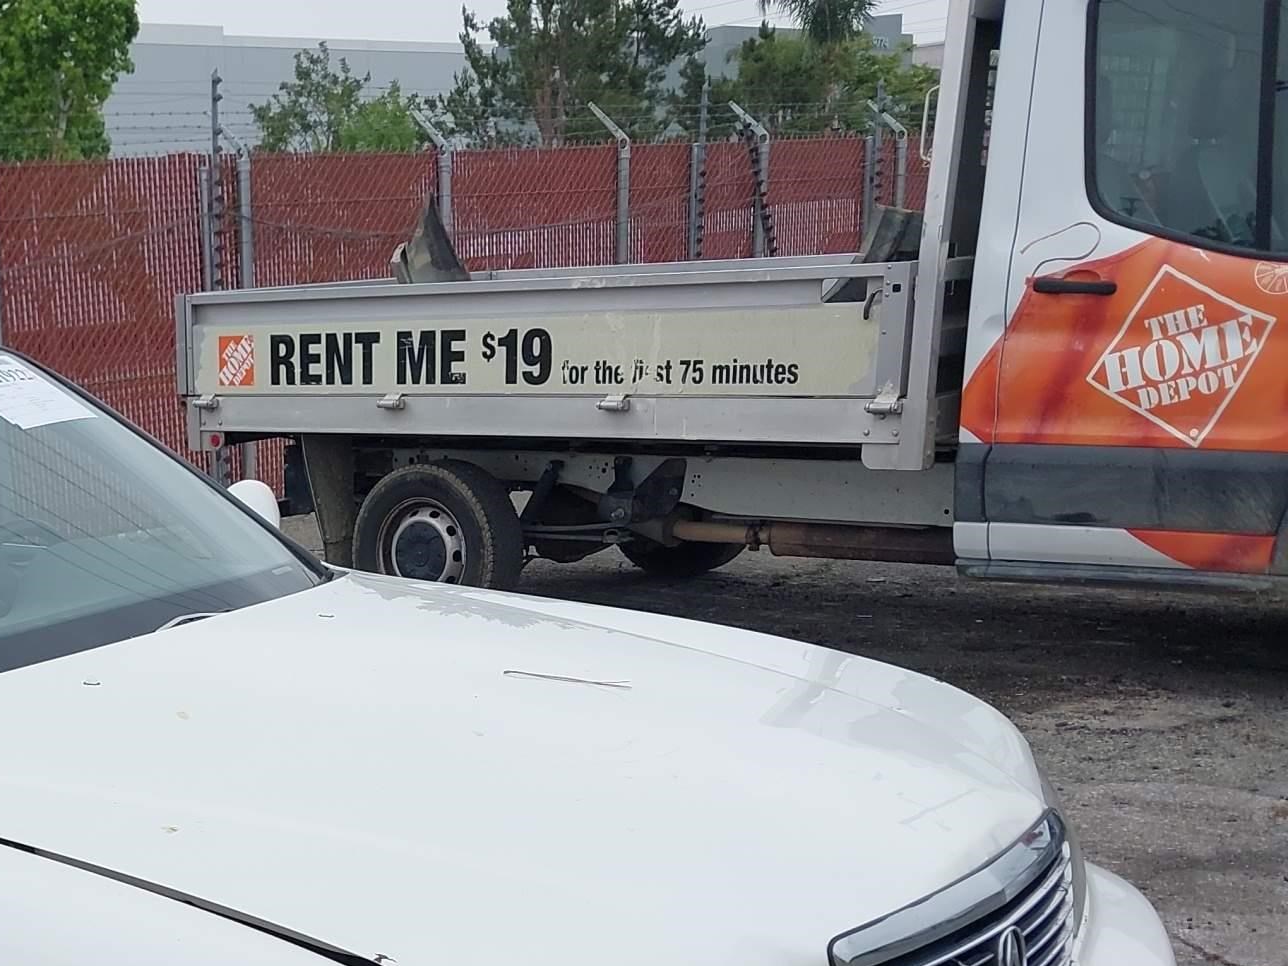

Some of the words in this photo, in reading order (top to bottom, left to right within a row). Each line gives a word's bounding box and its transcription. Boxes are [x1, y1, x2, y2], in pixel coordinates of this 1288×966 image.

[1144, 304, 1208, 340] THE
[219, 335, 253, 385] HOME
[270, 332, 380, 385] RENT
[396, 329, 466, 385] ME
[481, 328, 553, 386] $19
[562, 360, 588, 384] for
[594, 360, 624, 384] the
[679, 360, 704, 384] 75
[712, 359, 799, 384] minutes
[1102, 313, 1258, 393] HOME
[1137, 364, 1238, 410] DEPOT
